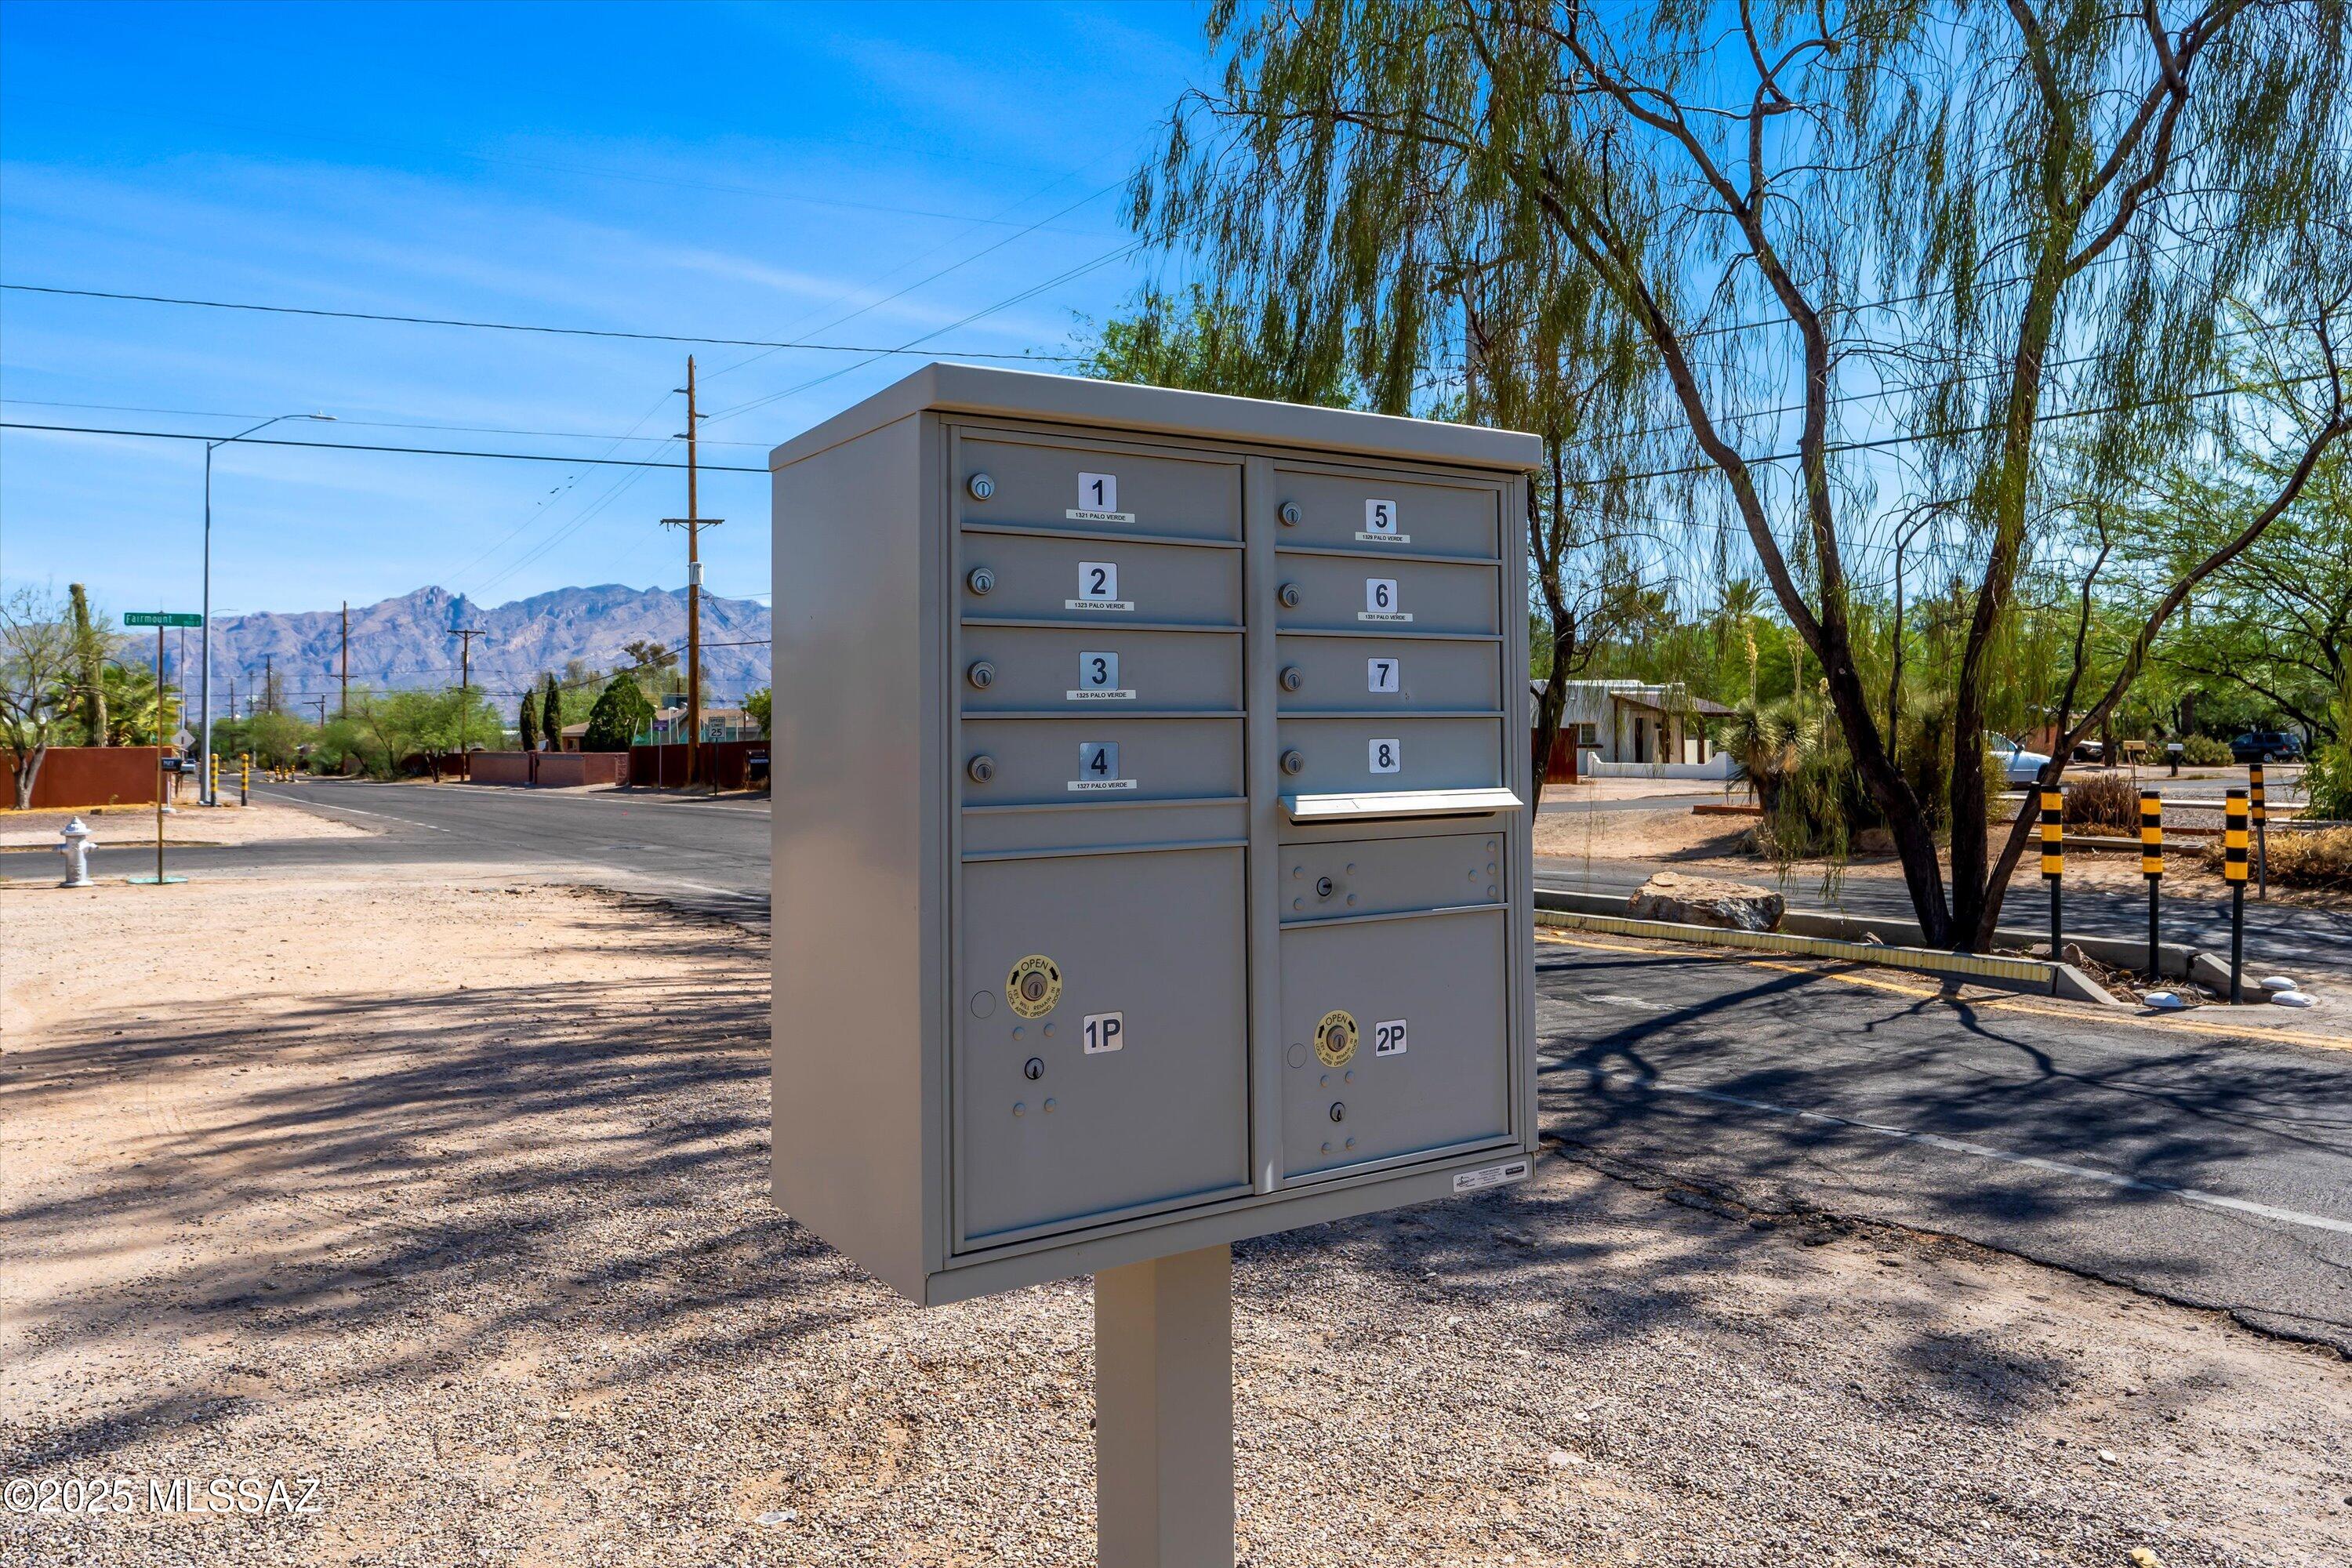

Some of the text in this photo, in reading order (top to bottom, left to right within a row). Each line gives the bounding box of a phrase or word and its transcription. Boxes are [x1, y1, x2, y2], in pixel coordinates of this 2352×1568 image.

[1092, 479, 1103, 506] 1
[1375, 505, 1388, 528] 5
[1091, 568, 1105, 594] 2
[1376, 584, 1388, 608] 6
[125, 614, 172, 624] Fairmount
[1092, 658, 1107, 684] 3
[1377, 664, 1389, 687] 7
[711, 728, 722, 737] 25
[1091, 749, 1108, 775] 4
[1378, 744, 1391, 768] 8
[1021, 959, 1049, 971] OPEN
[1014, 1007, 1028, 1017] AFTER
[1030, 1005, 1052, 1018] OPENING
[1052, 988, 1061, 1004] DOOR
[1020, 1001, 1029, 1011] WILL
[1033, 996, 1052, 1011] REMAIN
[1325, 1014, 1348, 1026] OPEN
[1086, 1019, 1121, 1048] 1P
[1377, 1025, 1405, 1052] 2P
